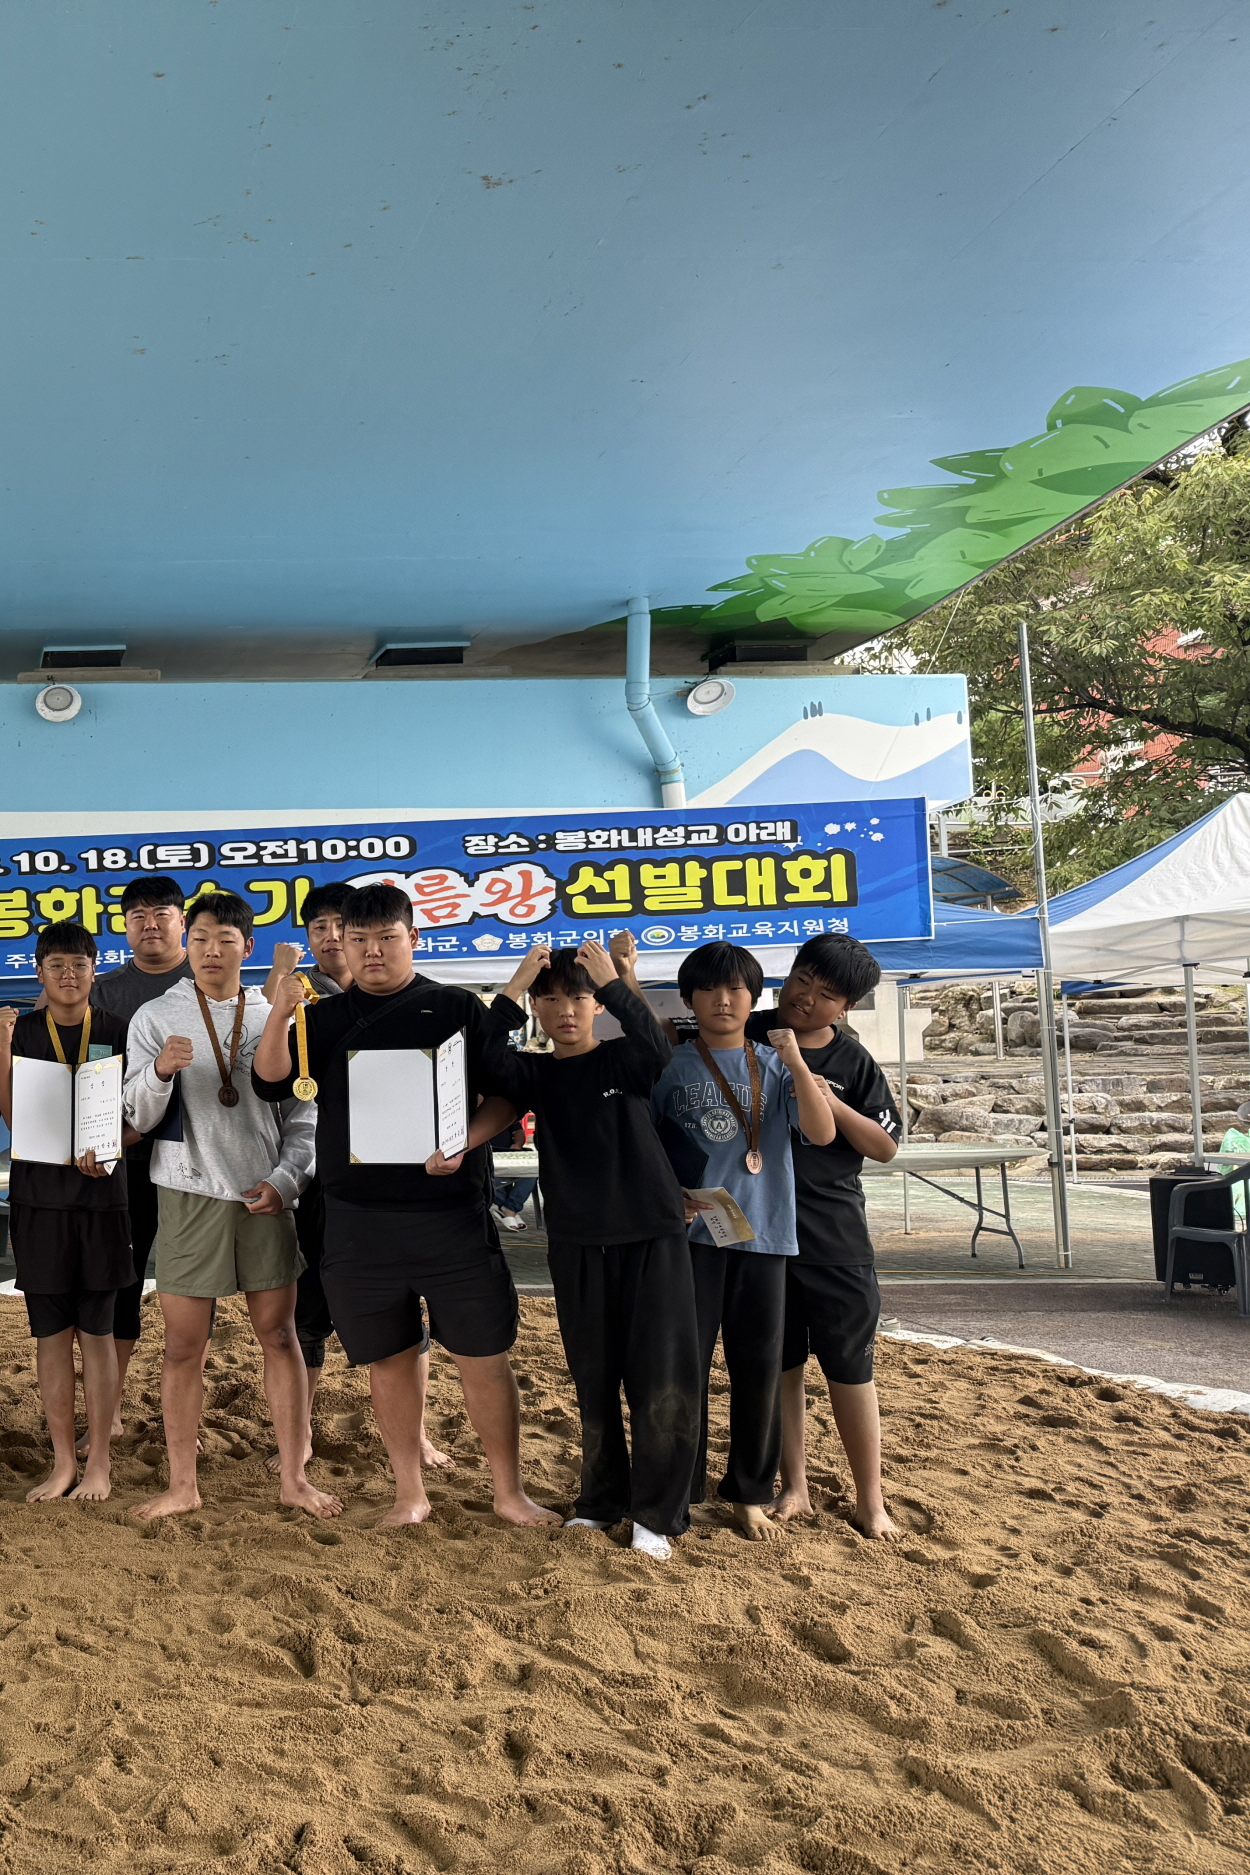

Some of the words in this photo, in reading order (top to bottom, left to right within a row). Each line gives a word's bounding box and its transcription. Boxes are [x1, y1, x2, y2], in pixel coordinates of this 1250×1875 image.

[554, 825, 718, 850] 봉화내성교
[726, 821, 792, 843] 아래
[565, 853, 848, 914] 선발대회
[680, 918, 849, 942] 봉화교육지원청
